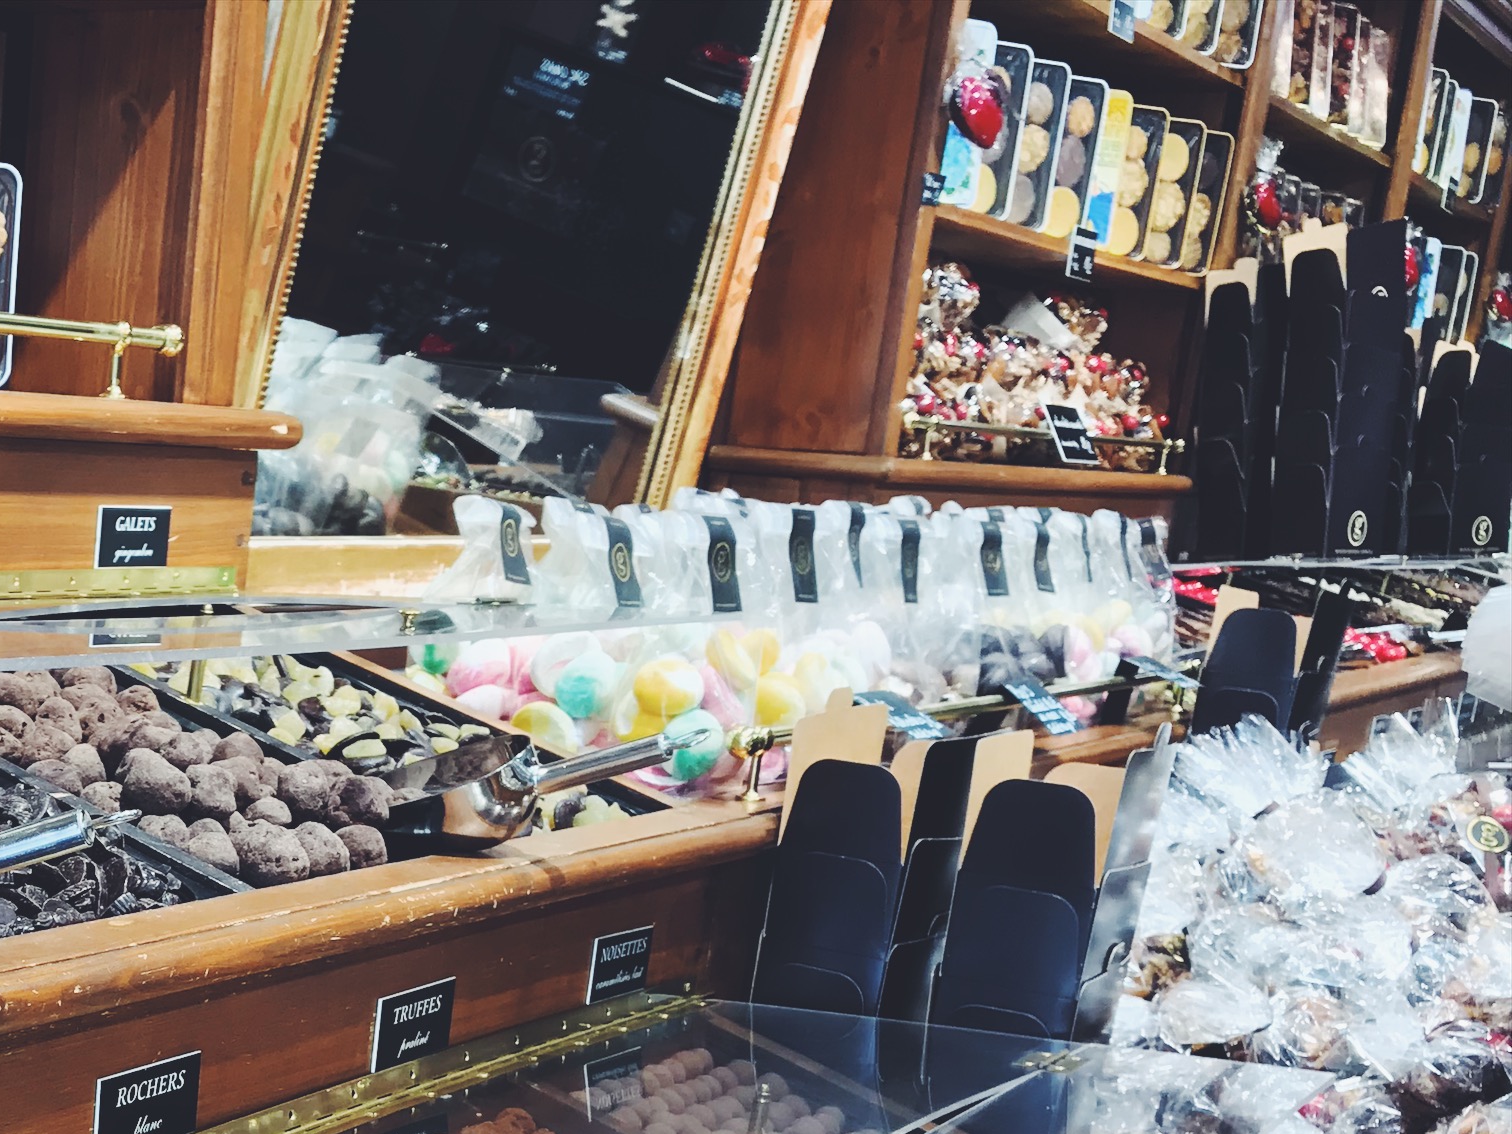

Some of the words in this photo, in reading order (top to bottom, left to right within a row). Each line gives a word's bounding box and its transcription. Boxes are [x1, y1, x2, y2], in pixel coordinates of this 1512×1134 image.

[115, 516, 157, 532] GALETS
[600, 936, 648, 963] NOISETTES
[393, 994, 443, 1025] TRUFFES
[115, 1069, 186, 1108] ROCHERS
